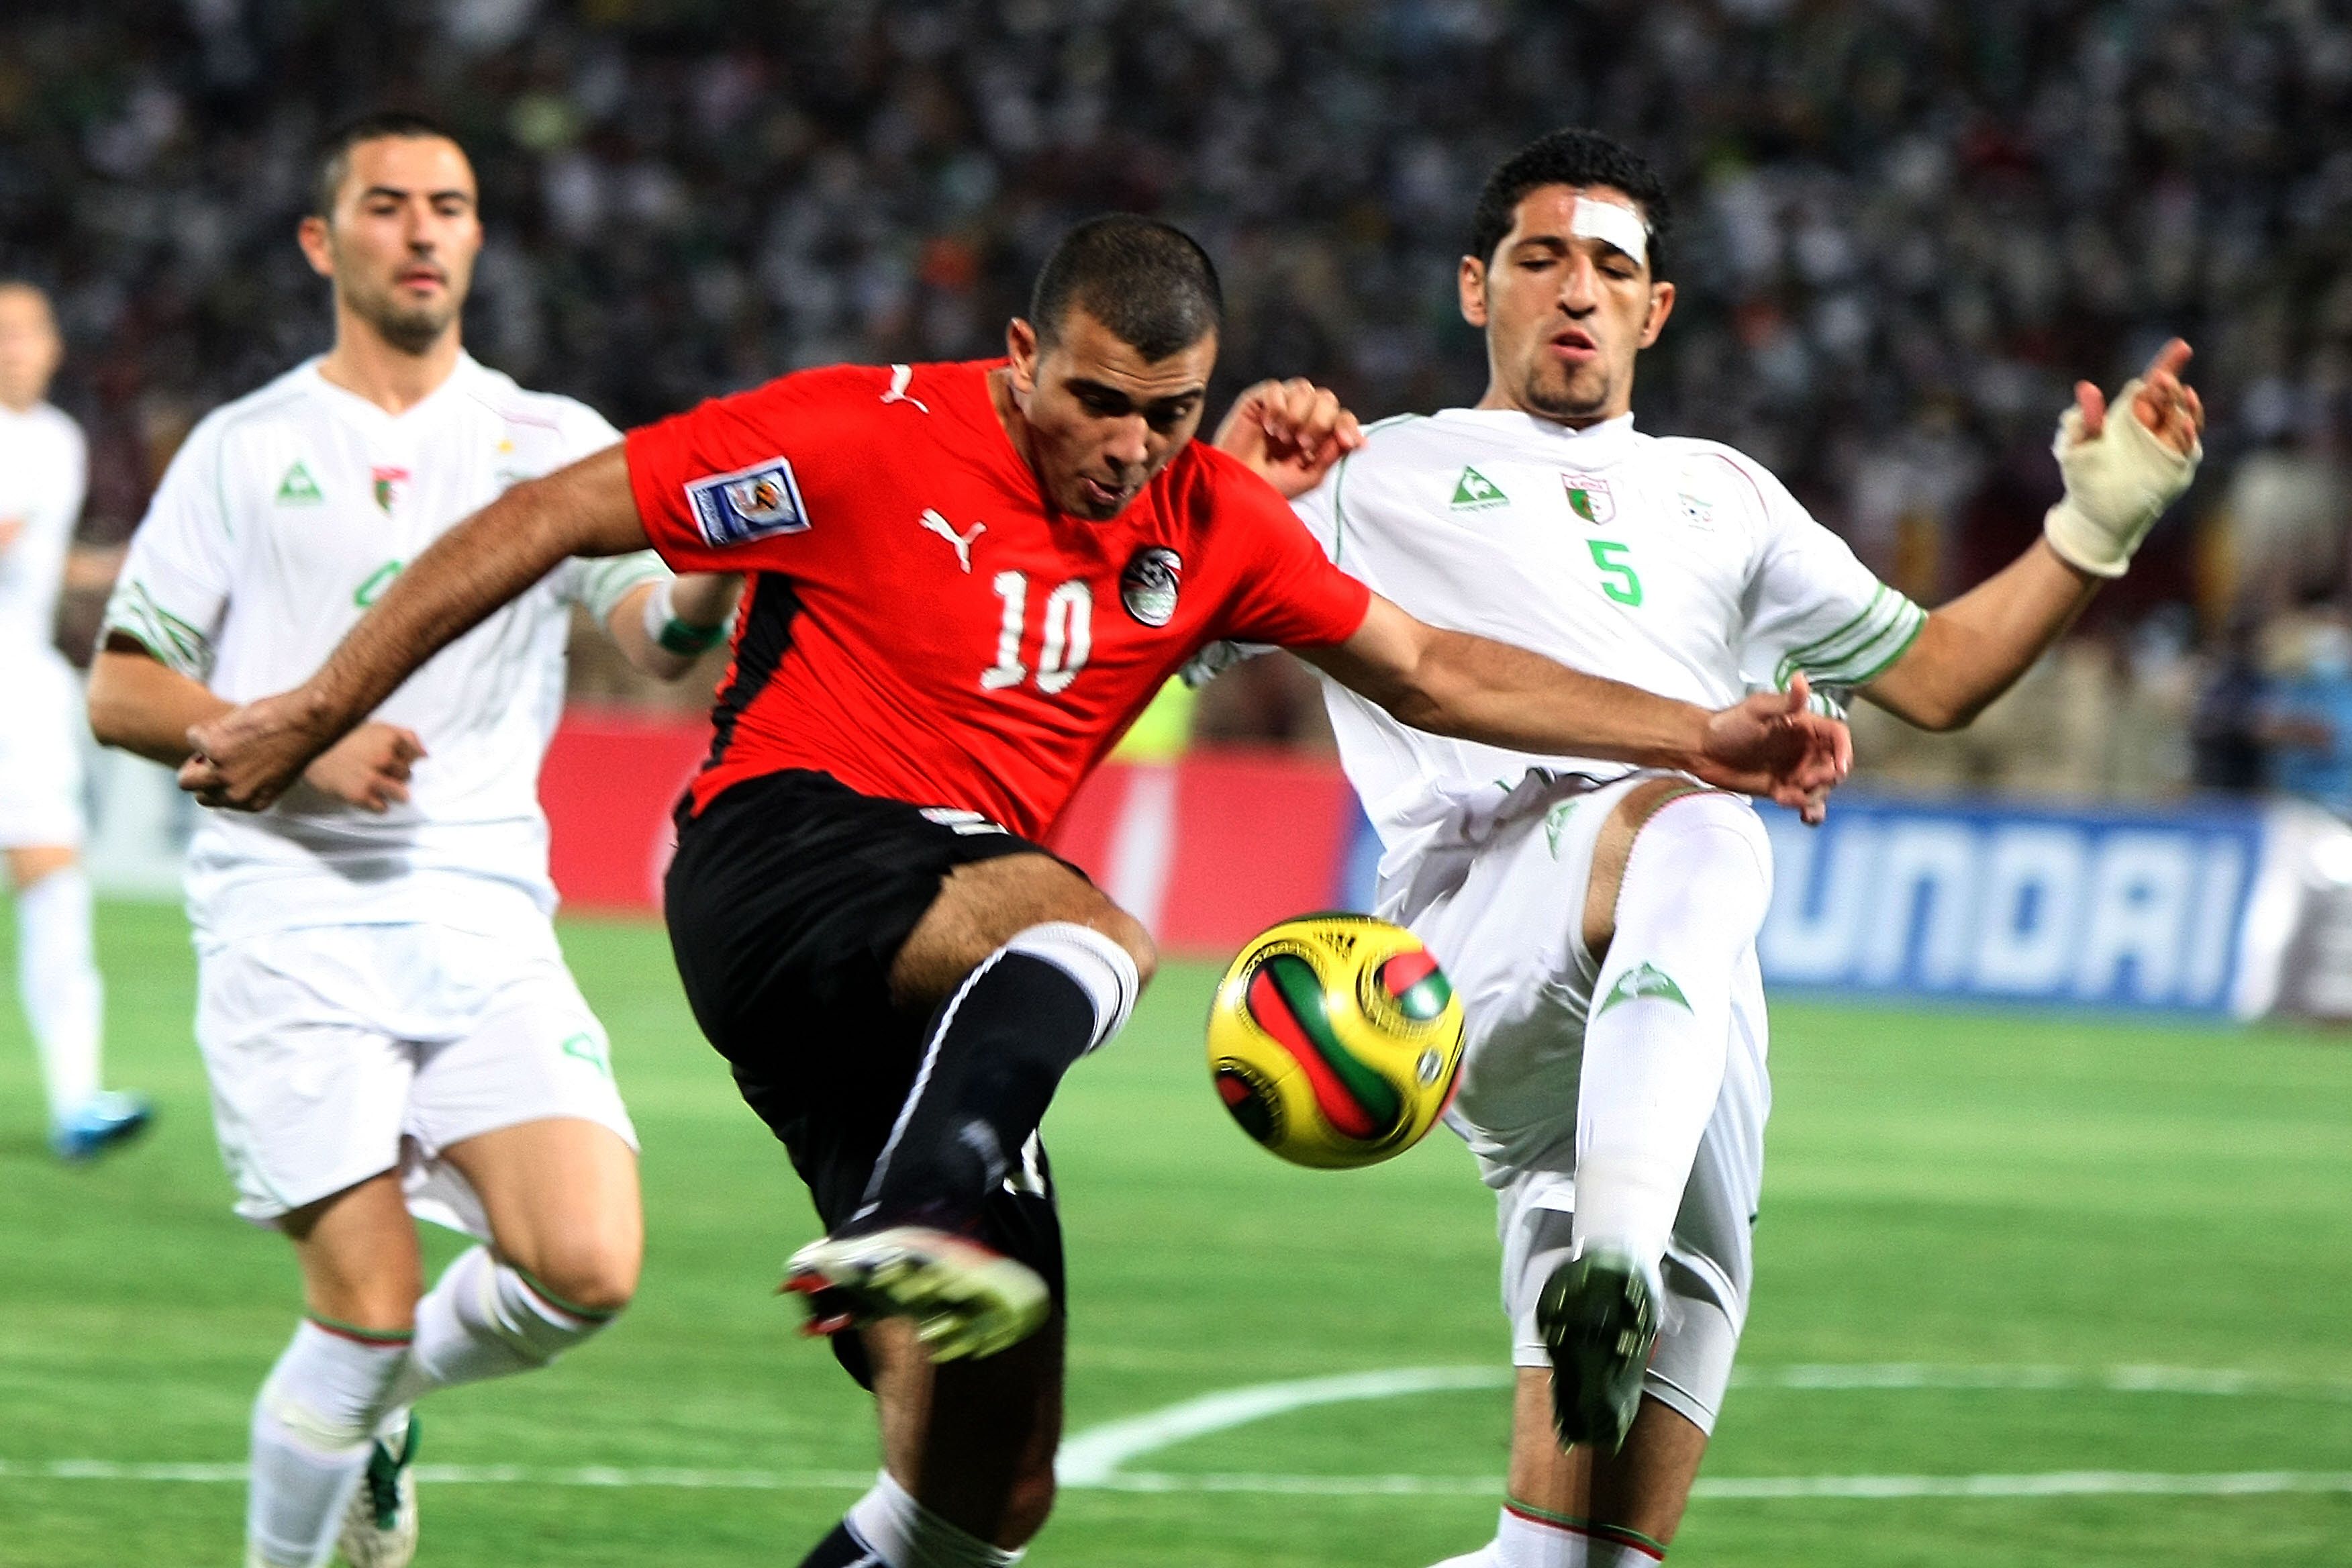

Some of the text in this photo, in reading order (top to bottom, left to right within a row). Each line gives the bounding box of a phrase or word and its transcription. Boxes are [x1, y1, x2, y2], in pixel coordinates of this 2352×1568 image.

[979, 571, 1093, 695] 10
[1587, 539, 1644, 607] 5
[1761, 819, 2243, 1003] UNDAI
